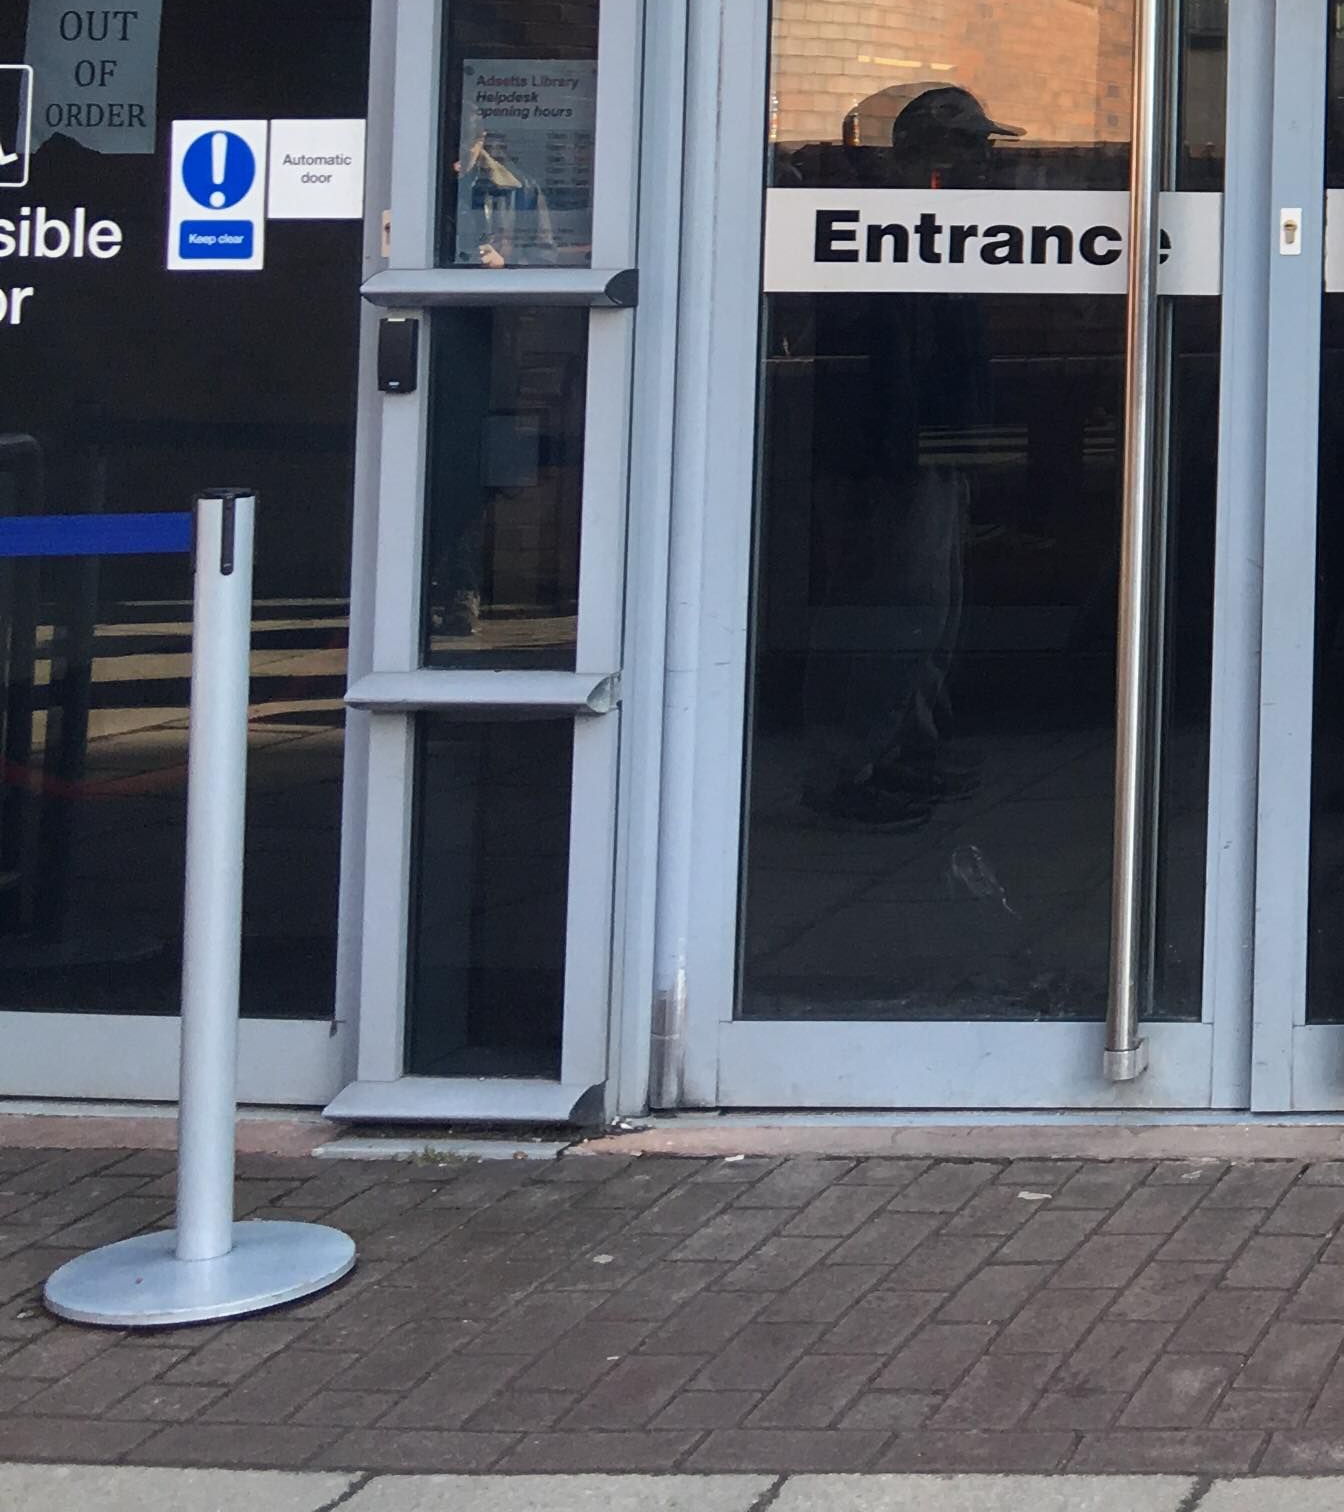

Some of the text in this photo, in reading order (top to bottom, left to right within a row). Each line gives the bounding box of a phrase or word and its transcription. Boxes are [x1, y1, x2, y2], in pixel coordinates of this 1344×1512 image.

[60, 10, 139, 42] OUT
[74, 59, 118, 88] OF
[45, 102, 147, 129] ORDER
[282, 153, 352, 166] Automatic
[300, 171, 333, 184] door
[188, 233, 245, 246] Keep clear
